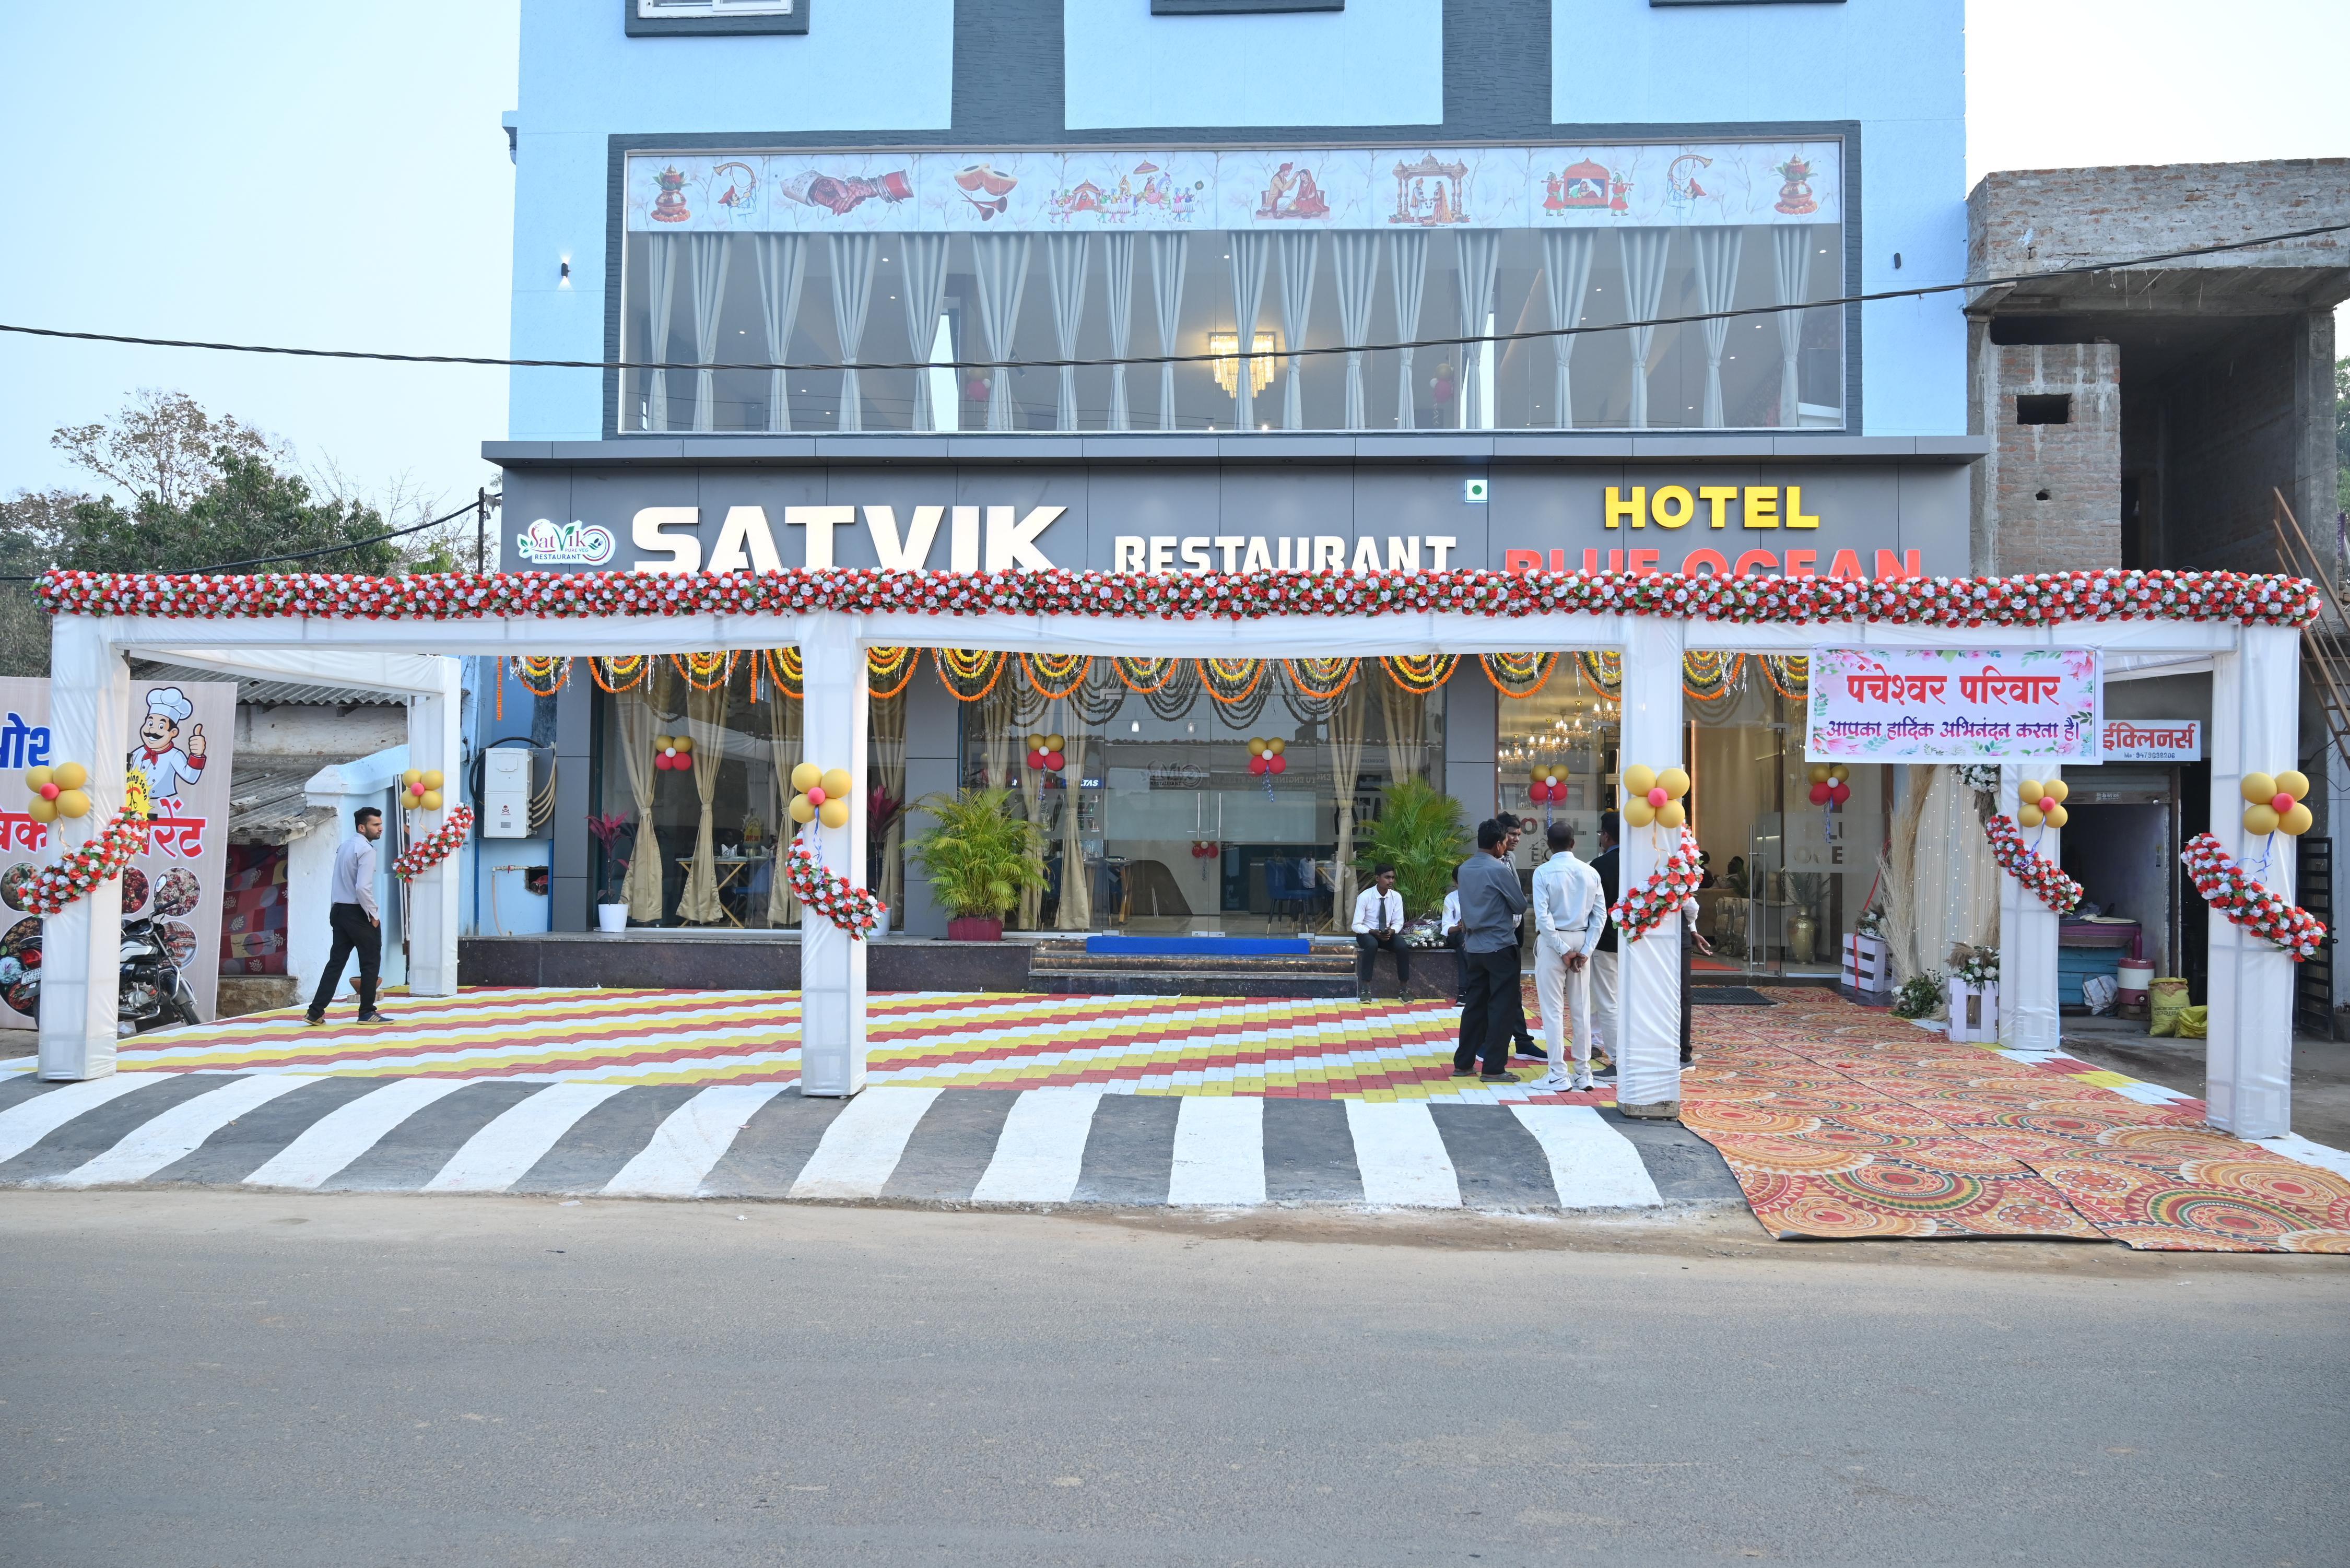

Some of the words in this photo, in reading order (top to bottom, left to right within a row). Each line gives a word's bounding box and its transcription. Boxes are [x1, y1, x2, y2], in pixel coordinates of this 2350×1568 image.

[1604, 485, 1819, 529] HOTEL
[632, 505, 1067, 573] SATVIK
[1114, 536, 1456, 573] RESTAURANT
[1681, 548, 1921, 578] OCEAN
[1847, 663, 1947, 705] पंचेश्वर
[1959, 665, 2061, 705] परिवार
[1826, 720, 1882, 738] आपका
[1887, 716, 1935, 740] हार्दिक
[1940, 716, 2011, 741] अभिनंदन
[2016, 722, 2059, 739] करता
